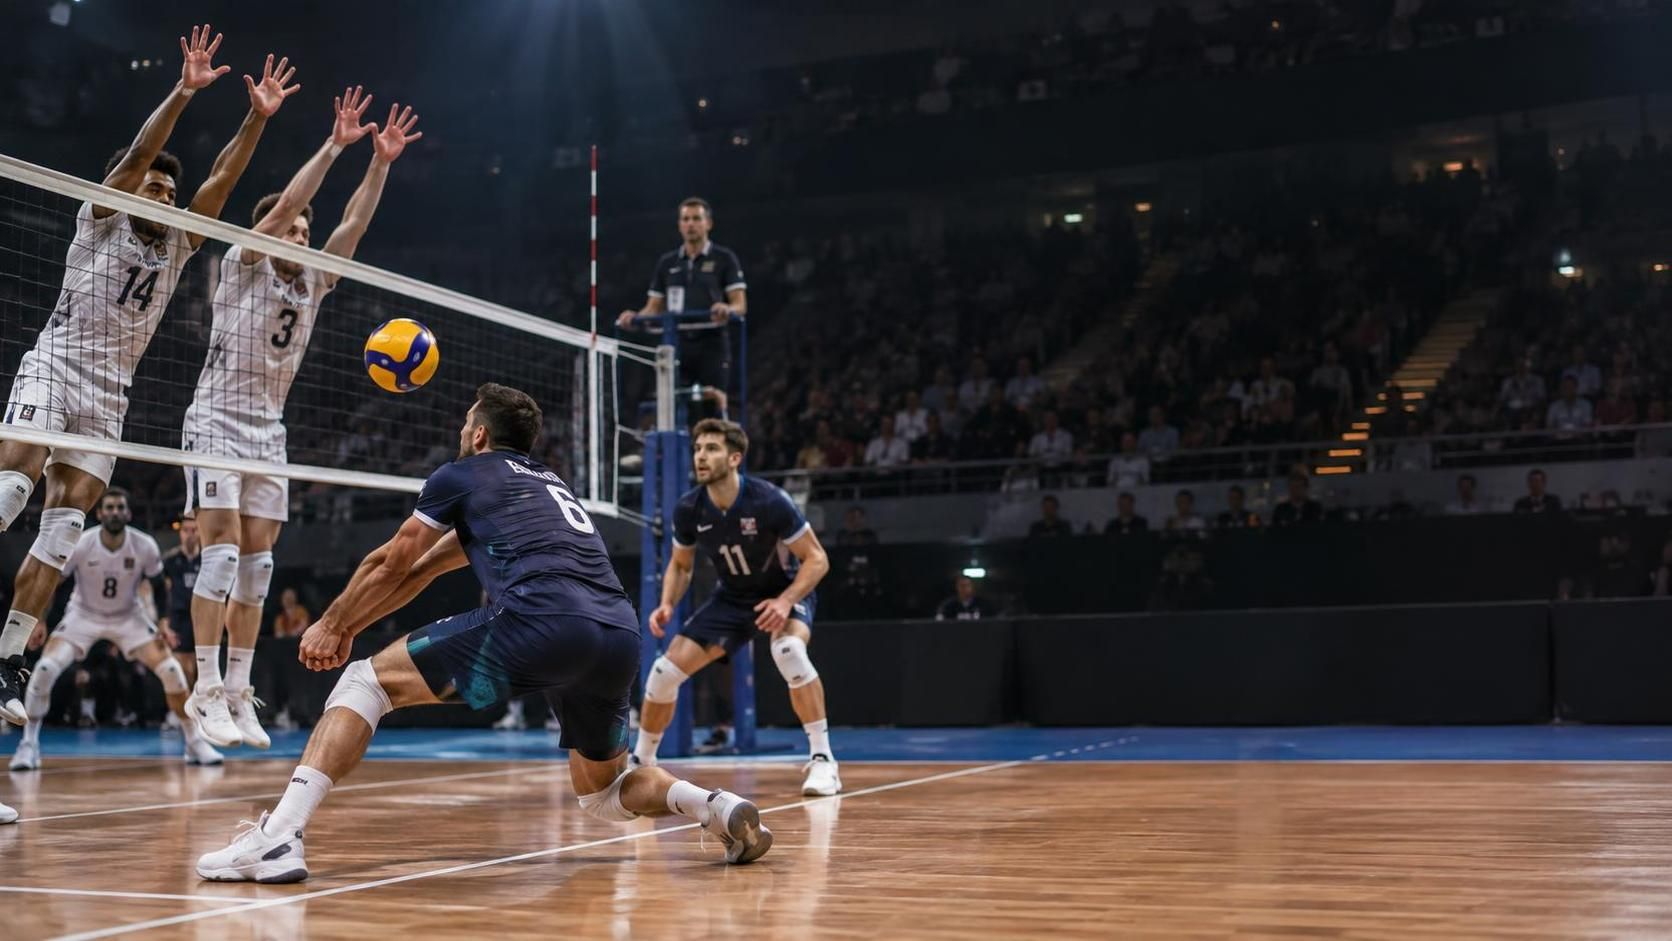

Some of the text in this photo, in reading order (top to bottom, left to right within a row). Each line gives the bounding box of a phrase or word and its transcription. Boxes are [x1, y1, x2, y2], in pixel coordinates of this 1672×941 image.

[117, 266, 159, 311] 14
[271, 309, 298, 348] 3
[546, 484, 594, 534] 6
[719, 544, 751, 575] 11
[103, 577, 117, 599] 8
